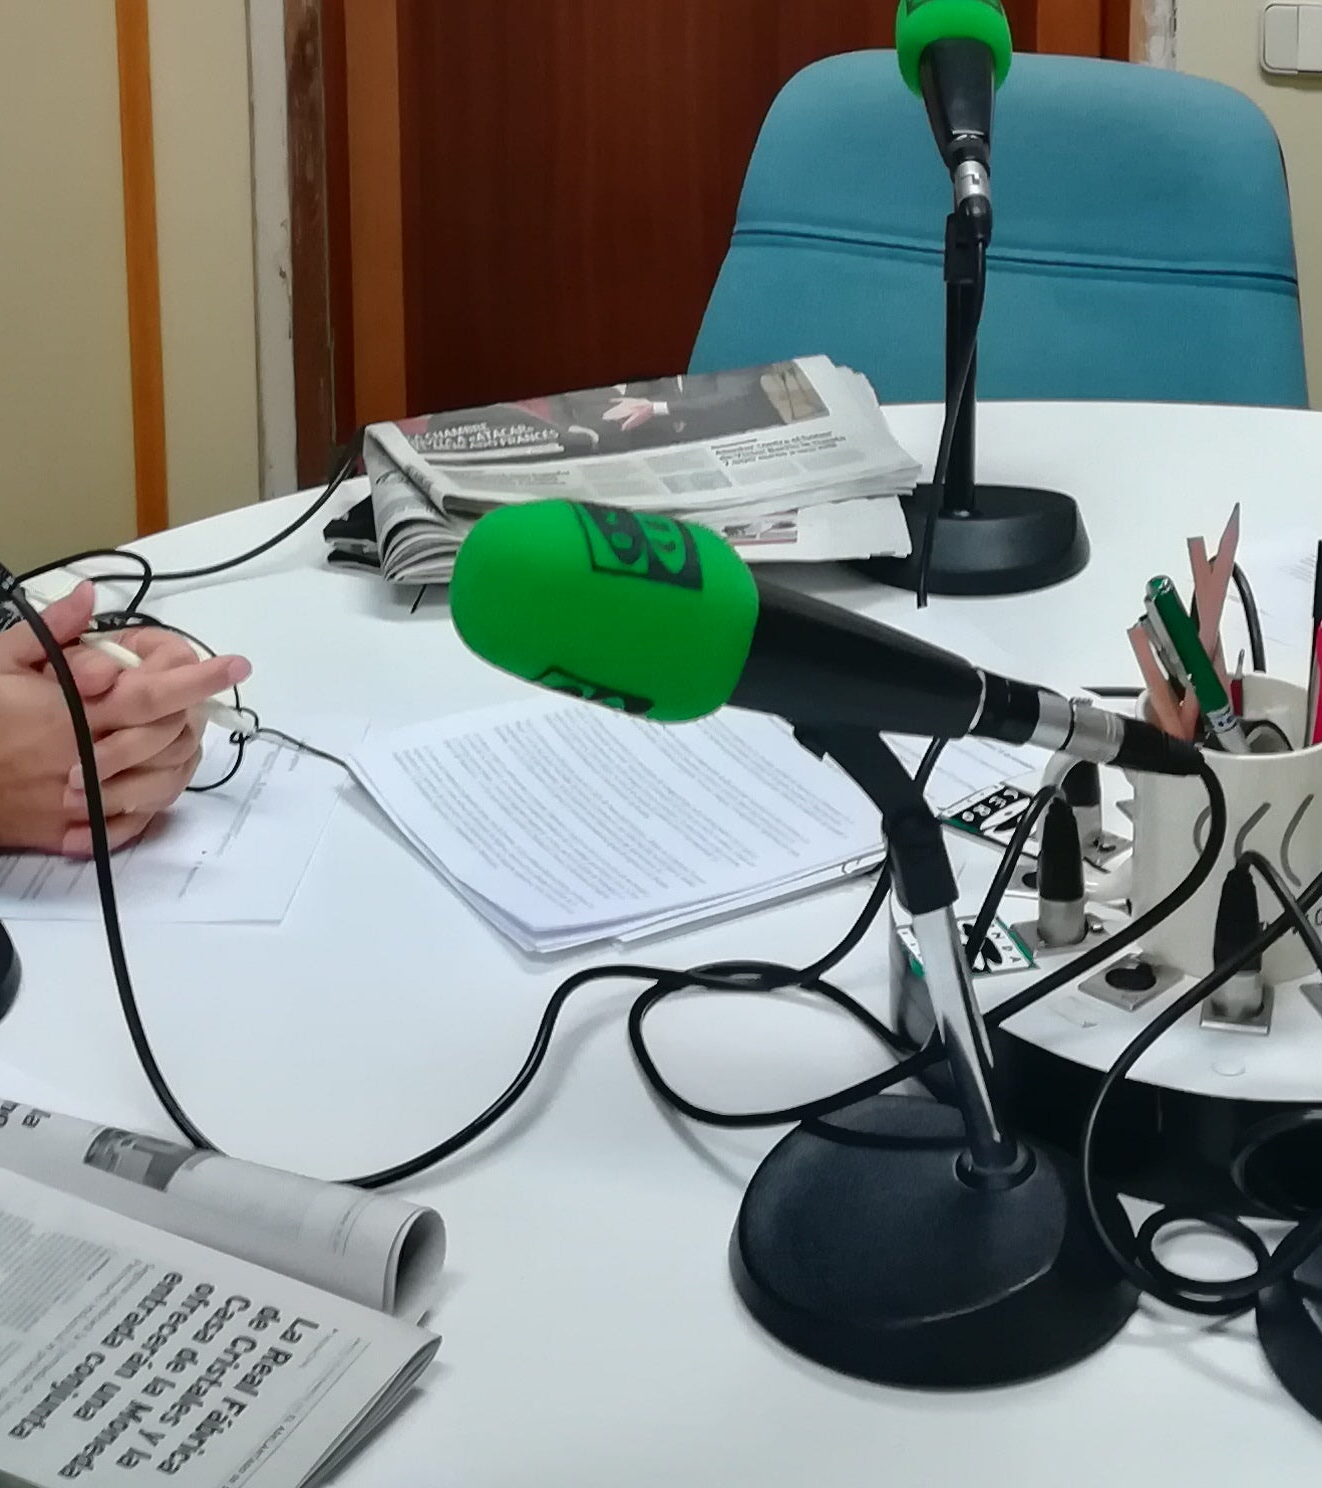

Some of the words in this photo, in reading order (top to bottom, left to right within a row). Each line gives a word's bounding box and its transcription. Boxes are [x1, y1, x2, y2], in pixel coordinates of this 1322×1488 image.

[101, 1271, 183, 1349] entrada
[113, 1282, 215, 1379] ofrecerán
[192, 1294, 251, 1345] Casa
[248, 1305, 281, 1332] de
[280, 1316, 319, 1345] La
[159, 1334, 258, 1428] Cristales
[165, 1346, 199, 1375] de
[238, 1347, 293, 1397] Real
[8, 1351, 106, 1440] conjunta
[72, 1380, 122, 1422] una
[140, 1375, 176, 1399] la
[57, 1399, 155, 1480] Moneda
[116, 1446, 152, 1470] la
[137, 1427, 165, 1449] y
[157, 1396, 248, 1475] Fábrica
